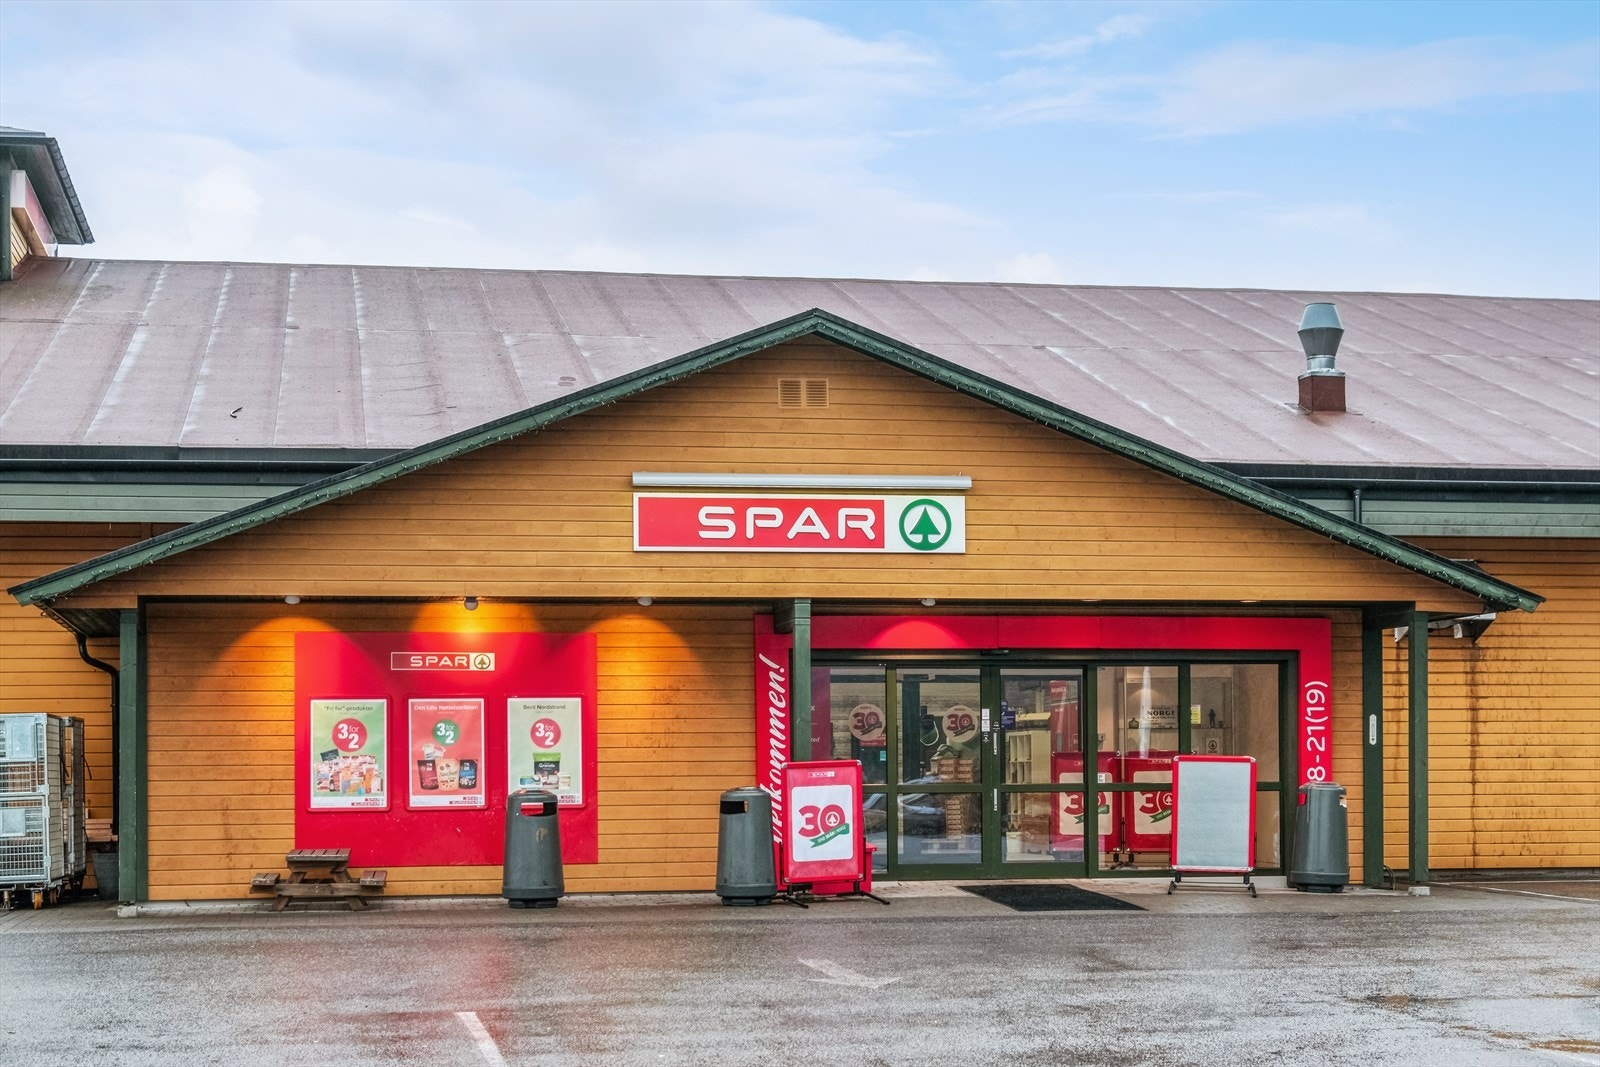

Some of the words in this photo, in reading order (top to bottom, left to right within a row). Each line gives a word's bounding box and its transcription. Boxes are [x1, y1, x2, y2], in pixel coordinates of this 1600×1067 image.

[698, 505, 876, 540] SPAR
[410, 655, 468, 667] SPAR
[349, 725, 360, 733] for
[853, 711, 880, 730] 30
[946, 713, 974, 732] 30
[337, 723, 349, 739] 3
[436, 722, 446, 736] 3
[445, 730, 455, 744] 2
[535, 722, 545, 737] 3
[544, 731, 555, 746] 2
[348, 733, 359, 749] 2
[798, 804, 846, 837] 30
